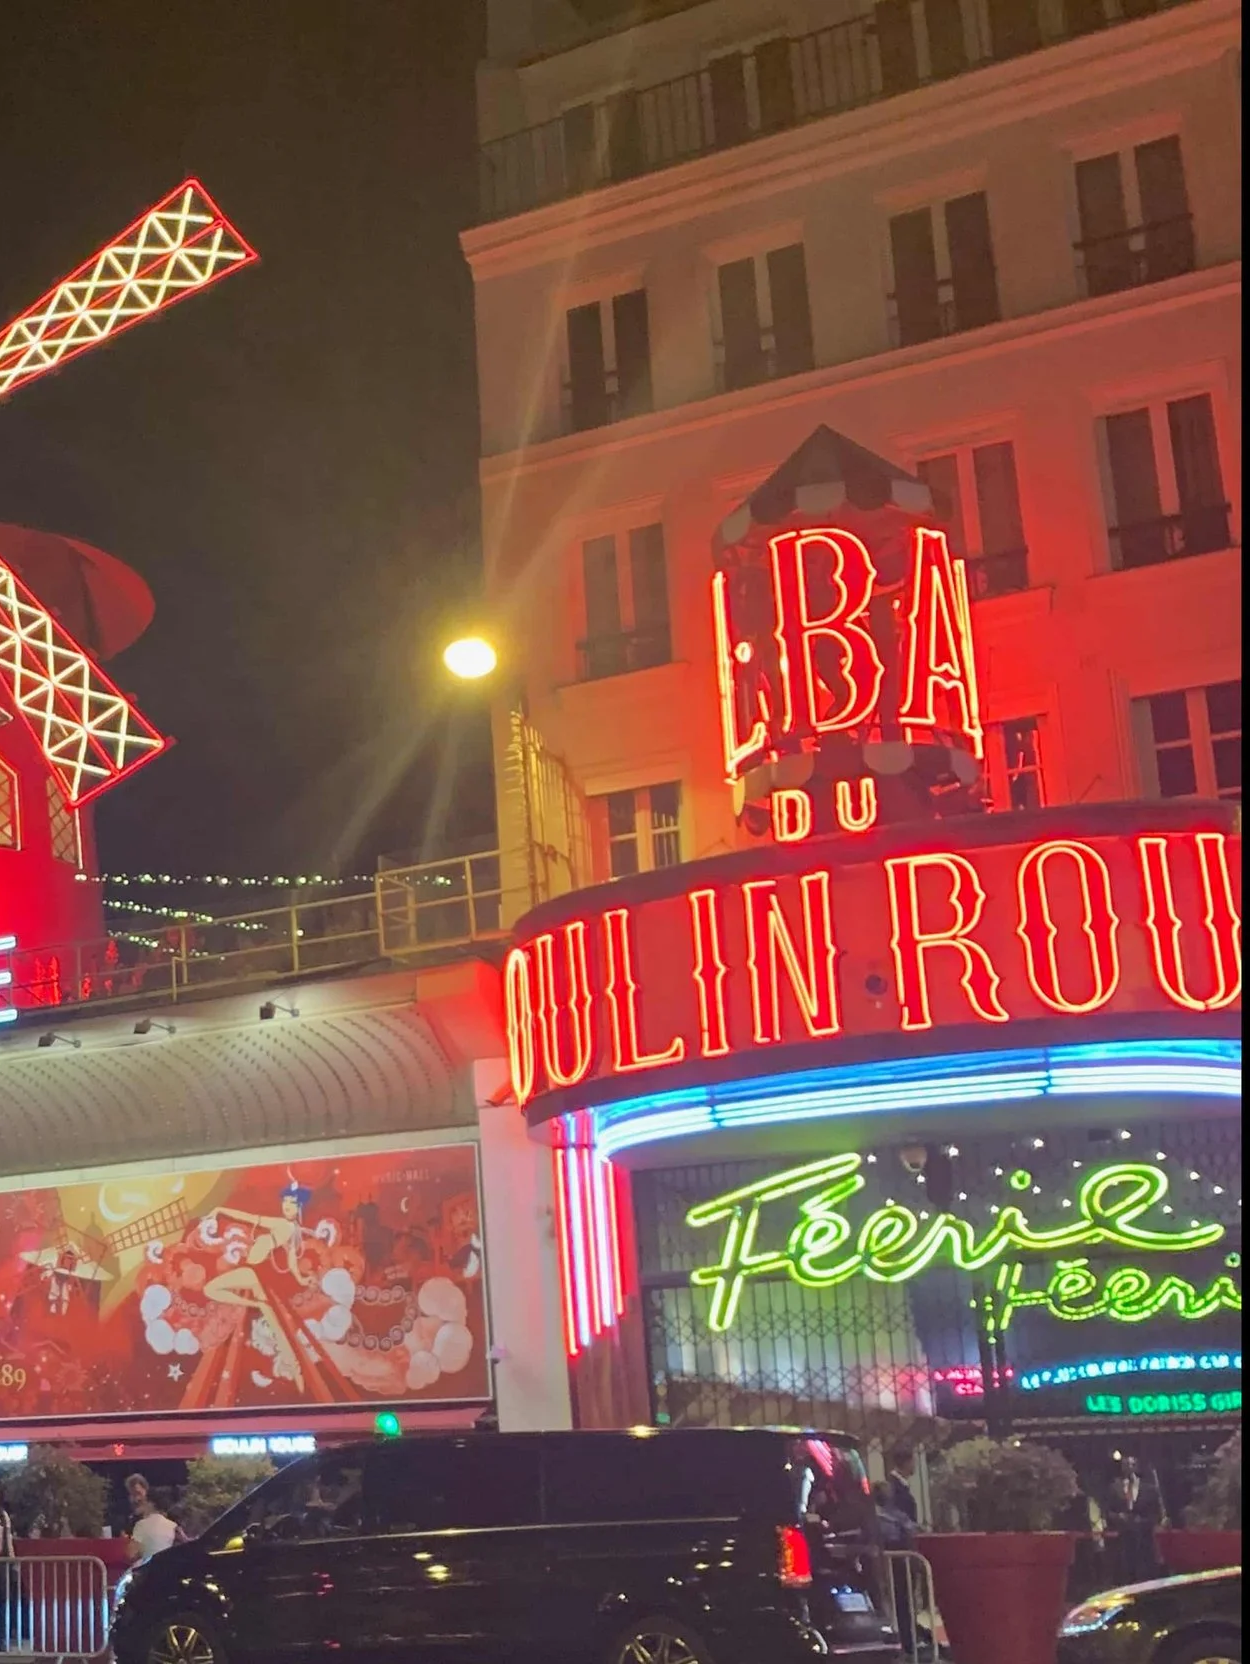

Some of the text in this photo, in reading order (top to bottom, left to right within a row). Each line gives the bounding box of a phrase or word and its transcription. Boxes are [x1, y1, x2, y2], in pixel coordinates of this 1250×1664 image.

[771, 777, 877, 843] DU
[884, 833, 1241, 1031] ROU
[685, 1151, 1225, 1333] Féerie
